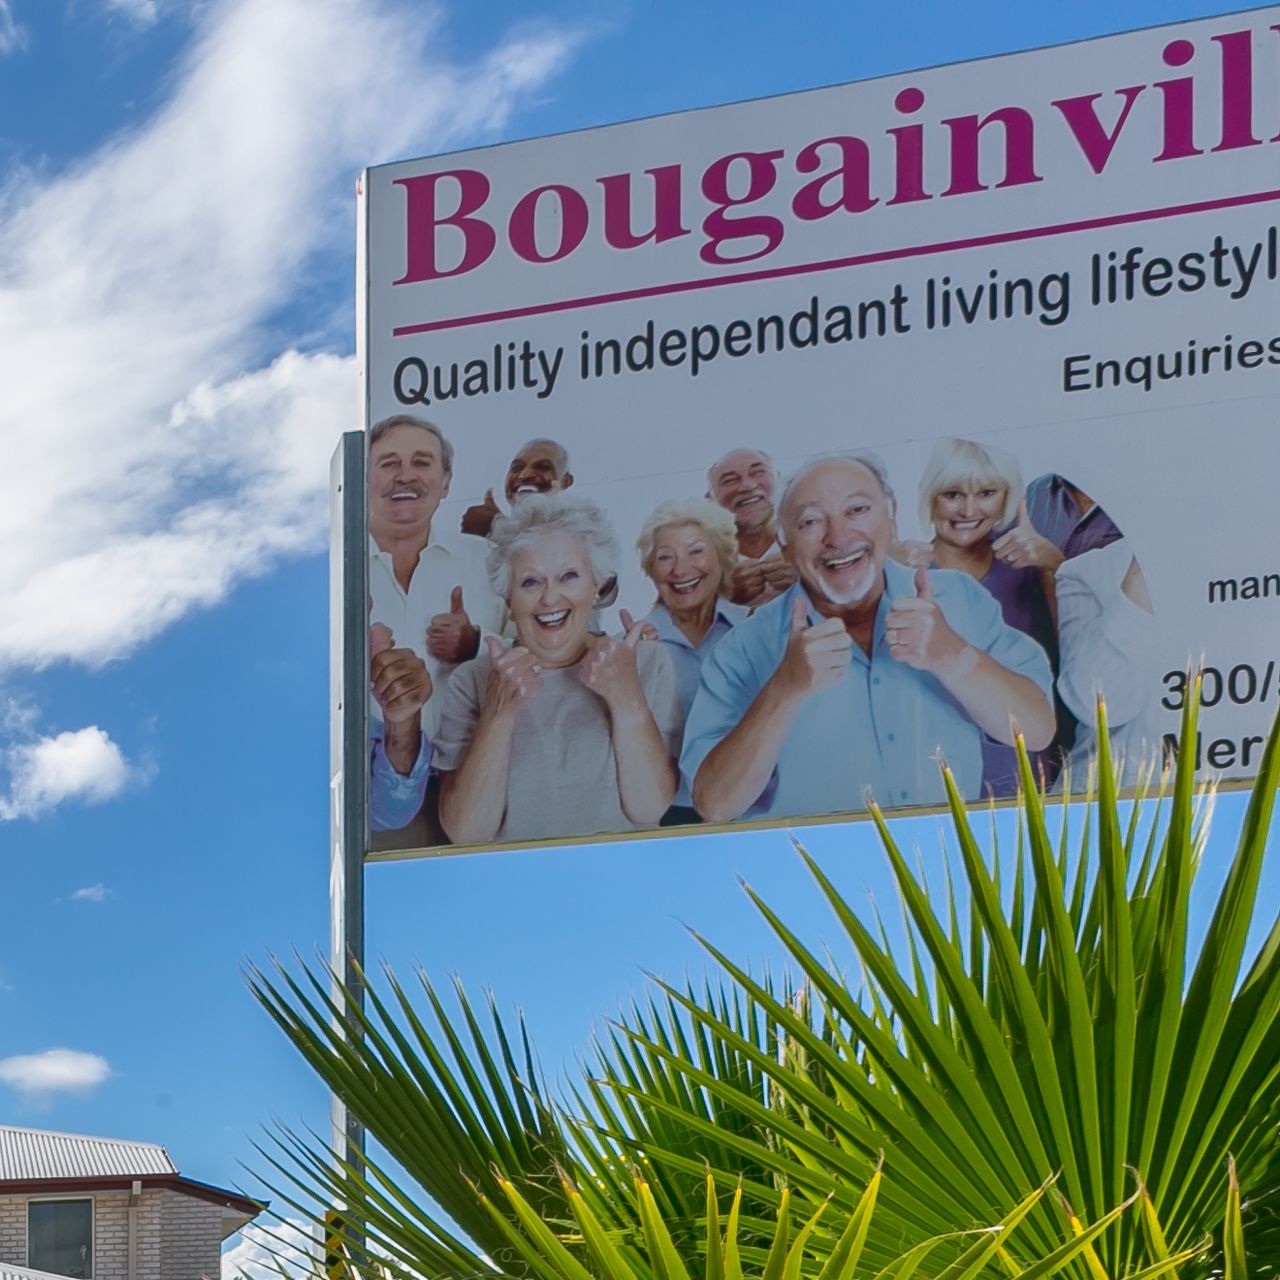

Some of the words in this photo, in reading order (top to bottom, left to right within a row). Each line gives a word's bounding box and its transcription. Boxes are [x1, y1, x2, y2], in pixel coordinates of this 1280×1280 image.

[392, 23, 1280, 287] Bougainvil
[392, 340, 563, 406] Quality
[580, 284, 911, 381] independant
[926, 268, 1071, 330] living
[1161, 660, 1280, 711] 300/
